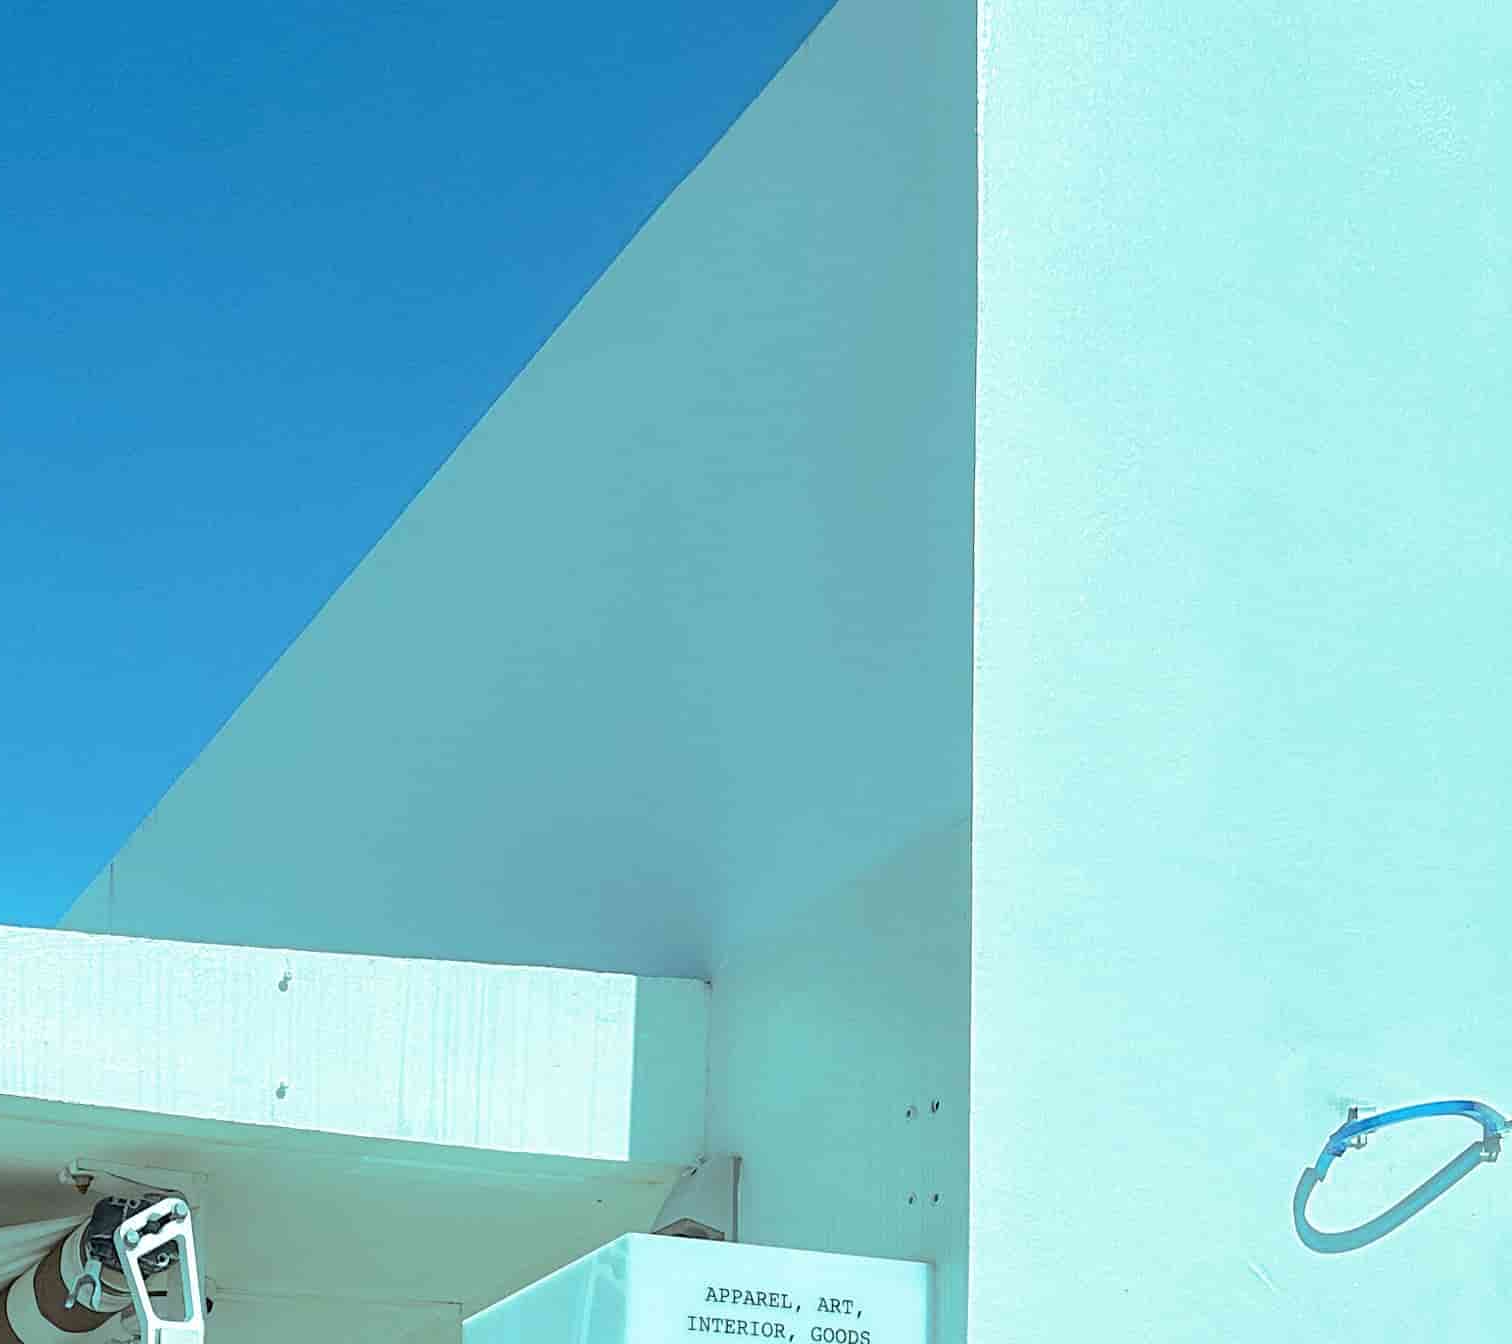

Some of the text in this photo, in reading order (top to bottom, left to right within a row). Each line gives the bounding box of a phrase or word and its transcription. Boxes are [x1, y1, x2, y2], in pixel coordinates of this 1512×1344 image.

[705, 1287, 864, 1319] APPAREL, ART,
[687, 1315, 795, 1343] INTERIOR,
